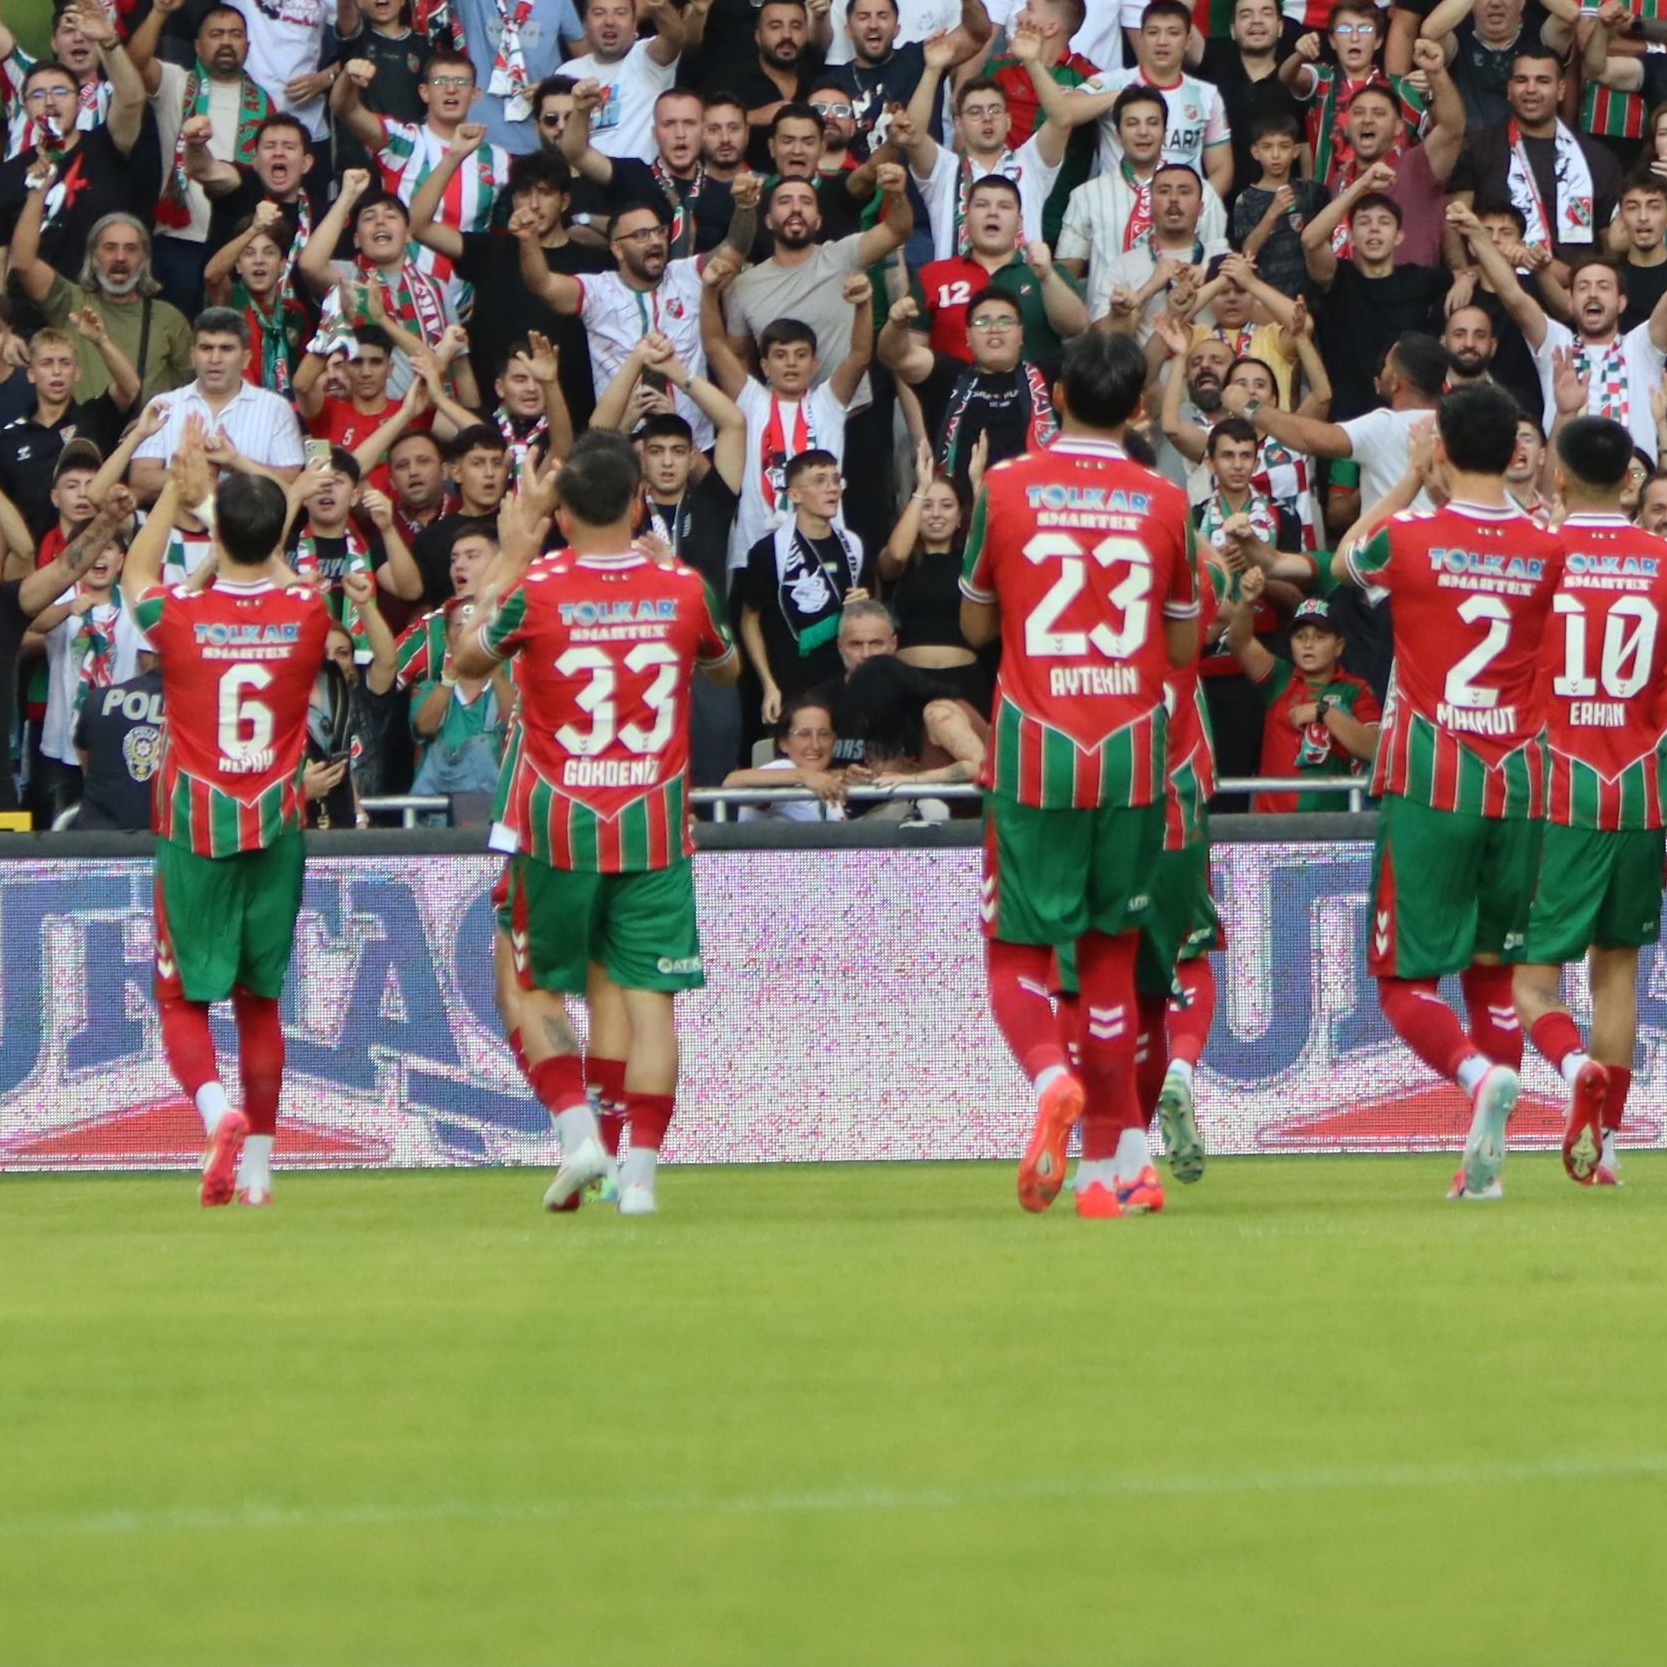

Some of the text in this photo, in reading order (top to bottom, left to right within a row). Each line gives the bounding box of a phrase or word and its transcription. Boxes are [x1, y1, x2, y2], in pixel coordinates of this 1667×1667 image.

[938, 281, 972, 309] 12
[1026, 485, 1150, 515] TOLKAR
[1037, 512, 1140, 531] SMARTEX
[1429, 548, 1543, 582] TOLKAR
[1565, 553, 1659, 577] OLKAR
[1022, 533, 1152, 658] 23
[1438, 574, 1535, 597] SMARTEX
[1562, 575, 1652, 591] SMARTEX
[558, 600, 678, 626] TOLKAR
[194, 622, 299, 644] TOLKAR
[569, 624, 669, 642] SMARTEX
[1553, 594, 1659, 698] 10
[202, 646, 292, 659] SMARTEX
[1444, 594, 1511, 707] 2
[100, 688, 166, 725] POL
[218, 663, 275, 762] 6
[553, 643, 678, 756] 33
[1570, 702, 1624, 727] ERHAN
